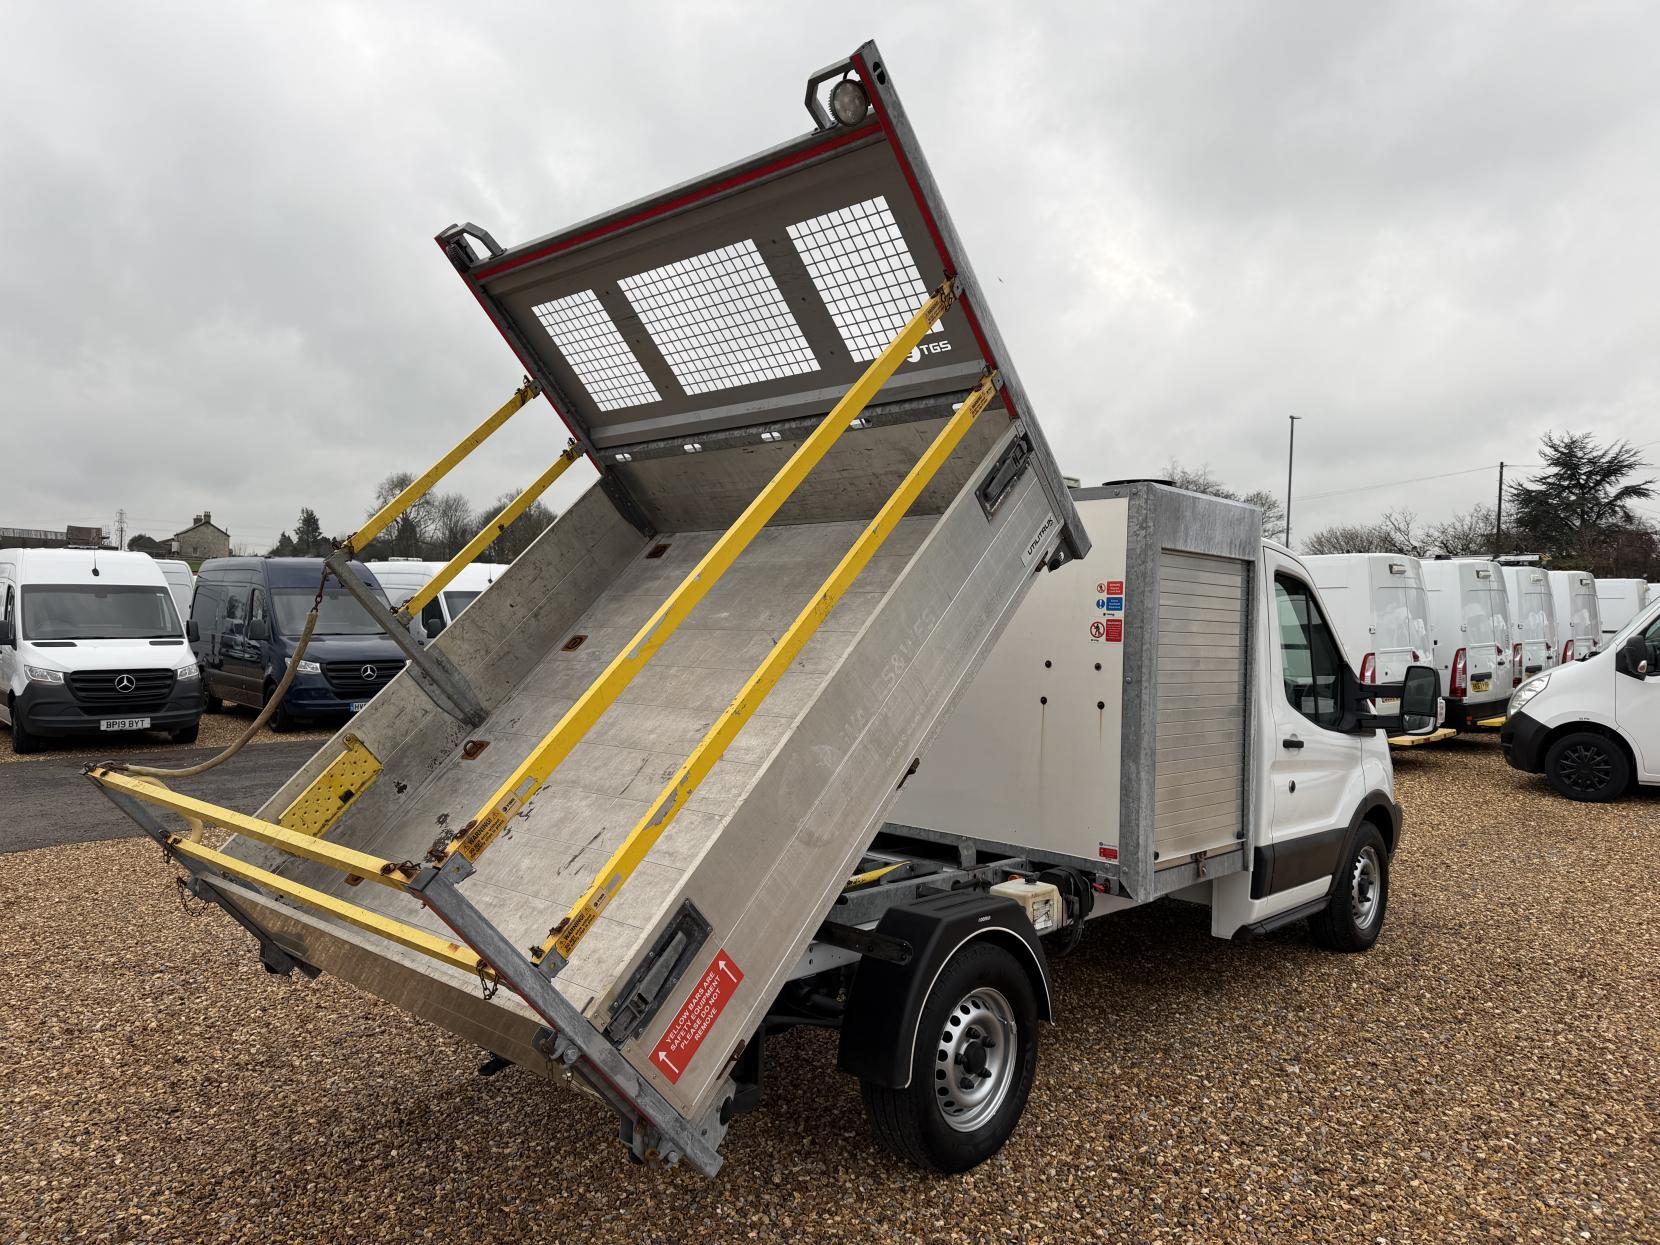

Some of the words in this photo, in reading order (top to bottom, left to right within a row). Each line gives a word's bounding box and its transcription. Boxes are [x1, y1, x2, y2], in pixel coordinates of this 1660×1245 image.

[919, 341, 952, 355] TGS
[128, 720, 145, 728] BYT
[467, 818, 492, 844] WARNING!
[666, 1009, 689, 1043] YELLOW
[688, 988, 704, 1011] BARS
[702, 971, 715, 989] ARE
[670, 1020, 692, 1052] SAFETY
[690, 975, 720, 1020] EQUIPMENT
[680, 1018, 702, 1050] PLEASE
[700, 1004, 710, 1019] DO
[709, 988, 721, 1005] NOT
[694, 1008, 718, 1041] REMOVE
